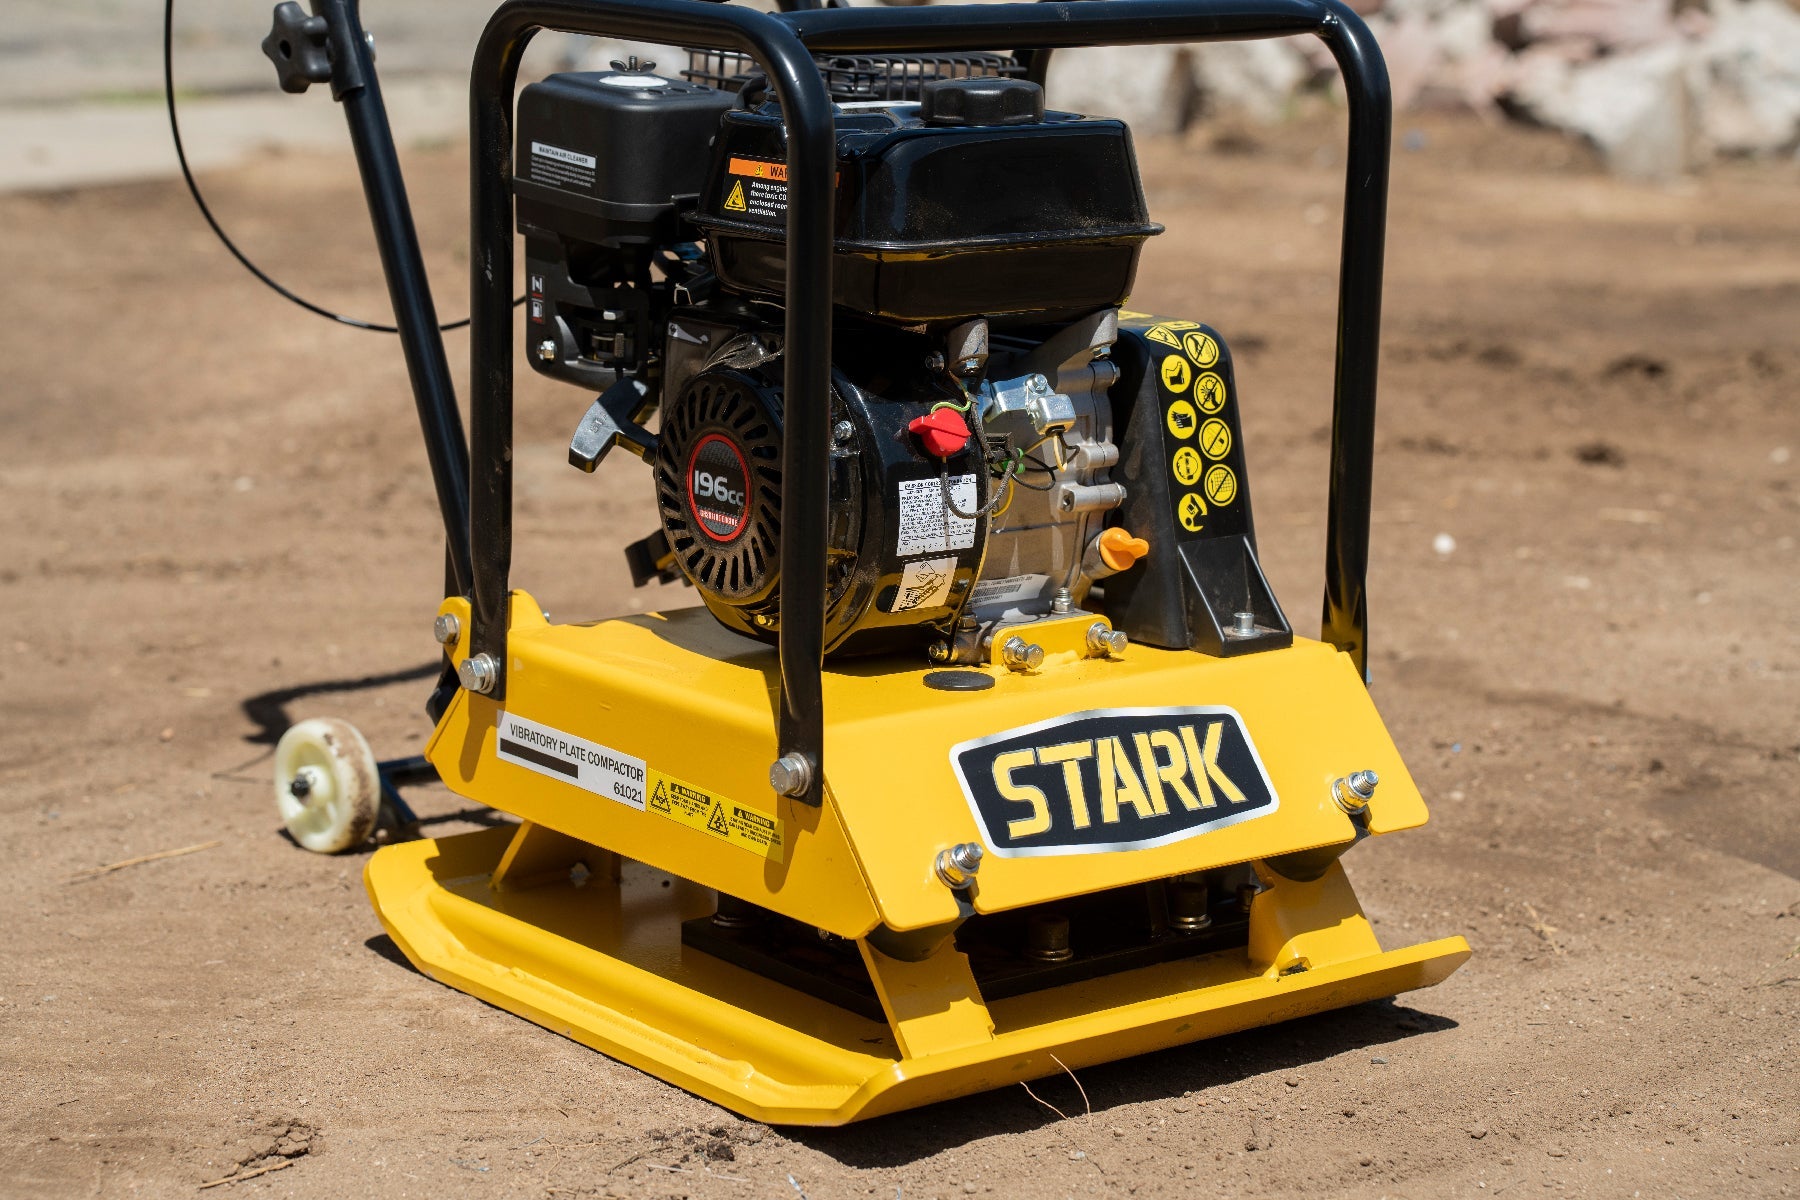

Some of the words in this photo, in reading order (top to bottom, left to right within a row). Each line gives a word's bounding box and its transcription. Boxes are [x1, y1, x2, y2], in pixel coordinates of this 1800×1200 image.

[538, 146, 559, 157] MAINTAIN
[567, 153, 588, 164] CLEANER
[694, 469, 744, 506] 196cc
[510, 722, 558, 752] VIBRATORY
[559, 740, 586, 762] PLATE
[587, 751, 644, 783] COMPACTOR
[613, 781, 644, 804] 61021
[991, 720, 1249, 840] STARK
[744, 811, 770, 828] WARNING
